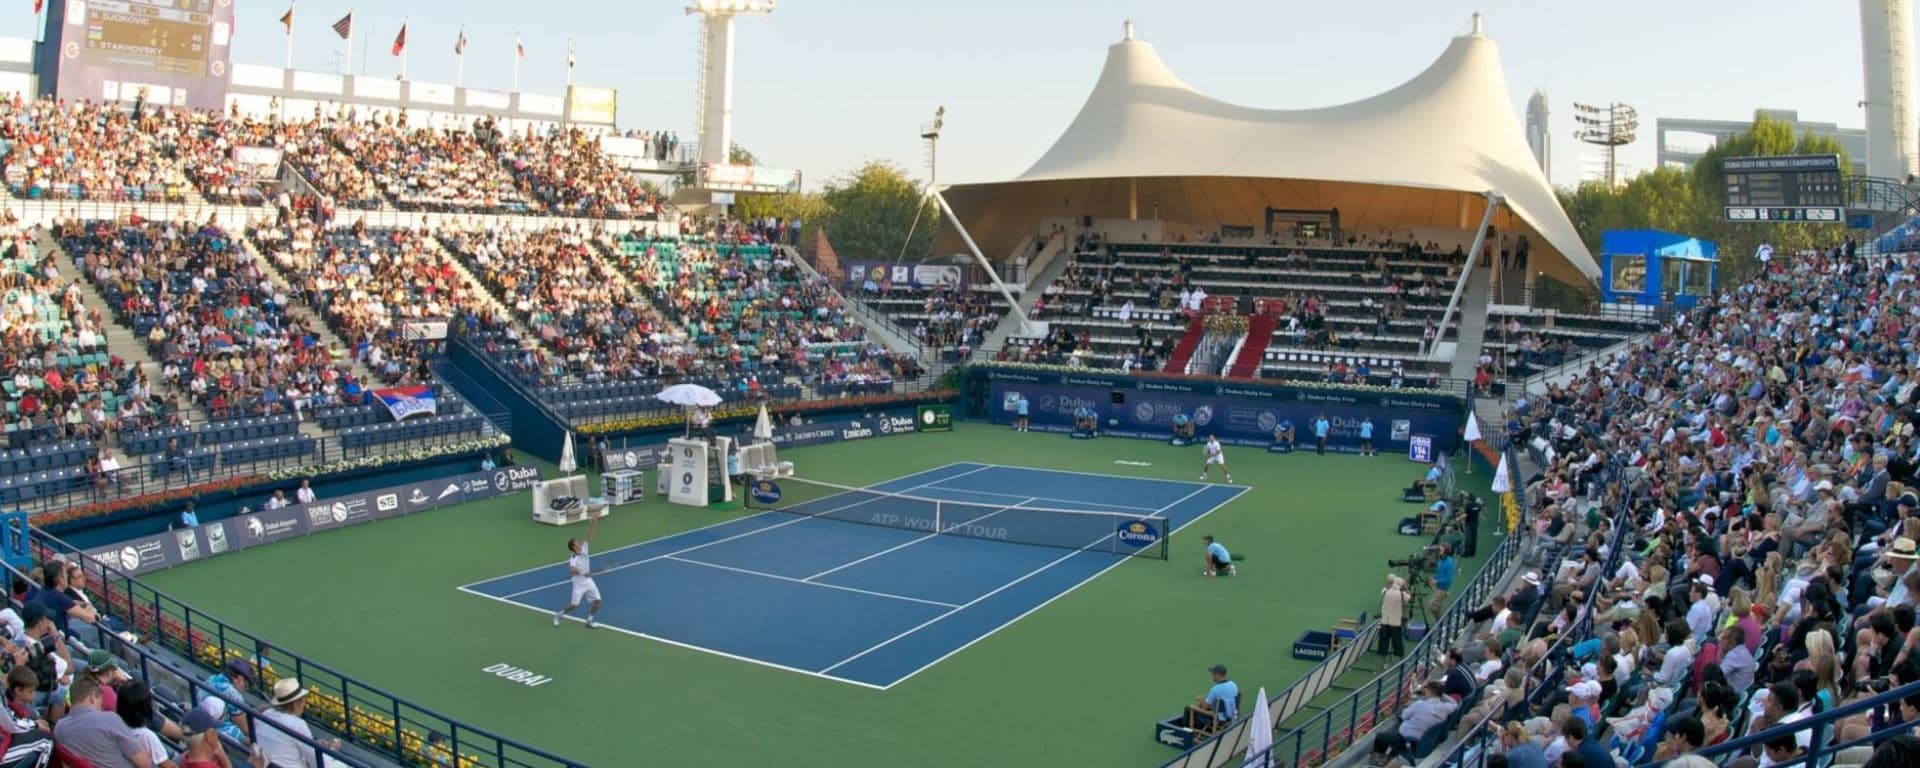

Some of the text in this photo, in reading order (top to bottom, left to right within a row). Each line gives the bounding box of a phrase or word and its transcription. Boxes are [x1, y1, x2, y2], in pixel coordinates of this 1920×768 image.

[103, 12, 150, 25] DJOKOVIC
[101, 41, 163, 56] STAKHOVSKY
[1725, 158, 1836, 169] DUBAI DUTY FREE TENNIS CHAMPIONSHIPS
[851, 421, 861, 429] Fly
[891, 416, 913, 426] Dubai
[1332, 417, 1361, 428] Dub
[844, 427, 872, 439] Emirates
[508, 467, 537, 480] Dubai
[512, 480, 526, 490] Duty
[751, 487, 779, 500] Corona
[871, 513, 1008, 540] ATP WORLD TOUR
[1118, 528, 1156, 542] Corona
[1295, 648, 1325, 657] LACOSTE
[482, 663, 552, 687] DUBAI
